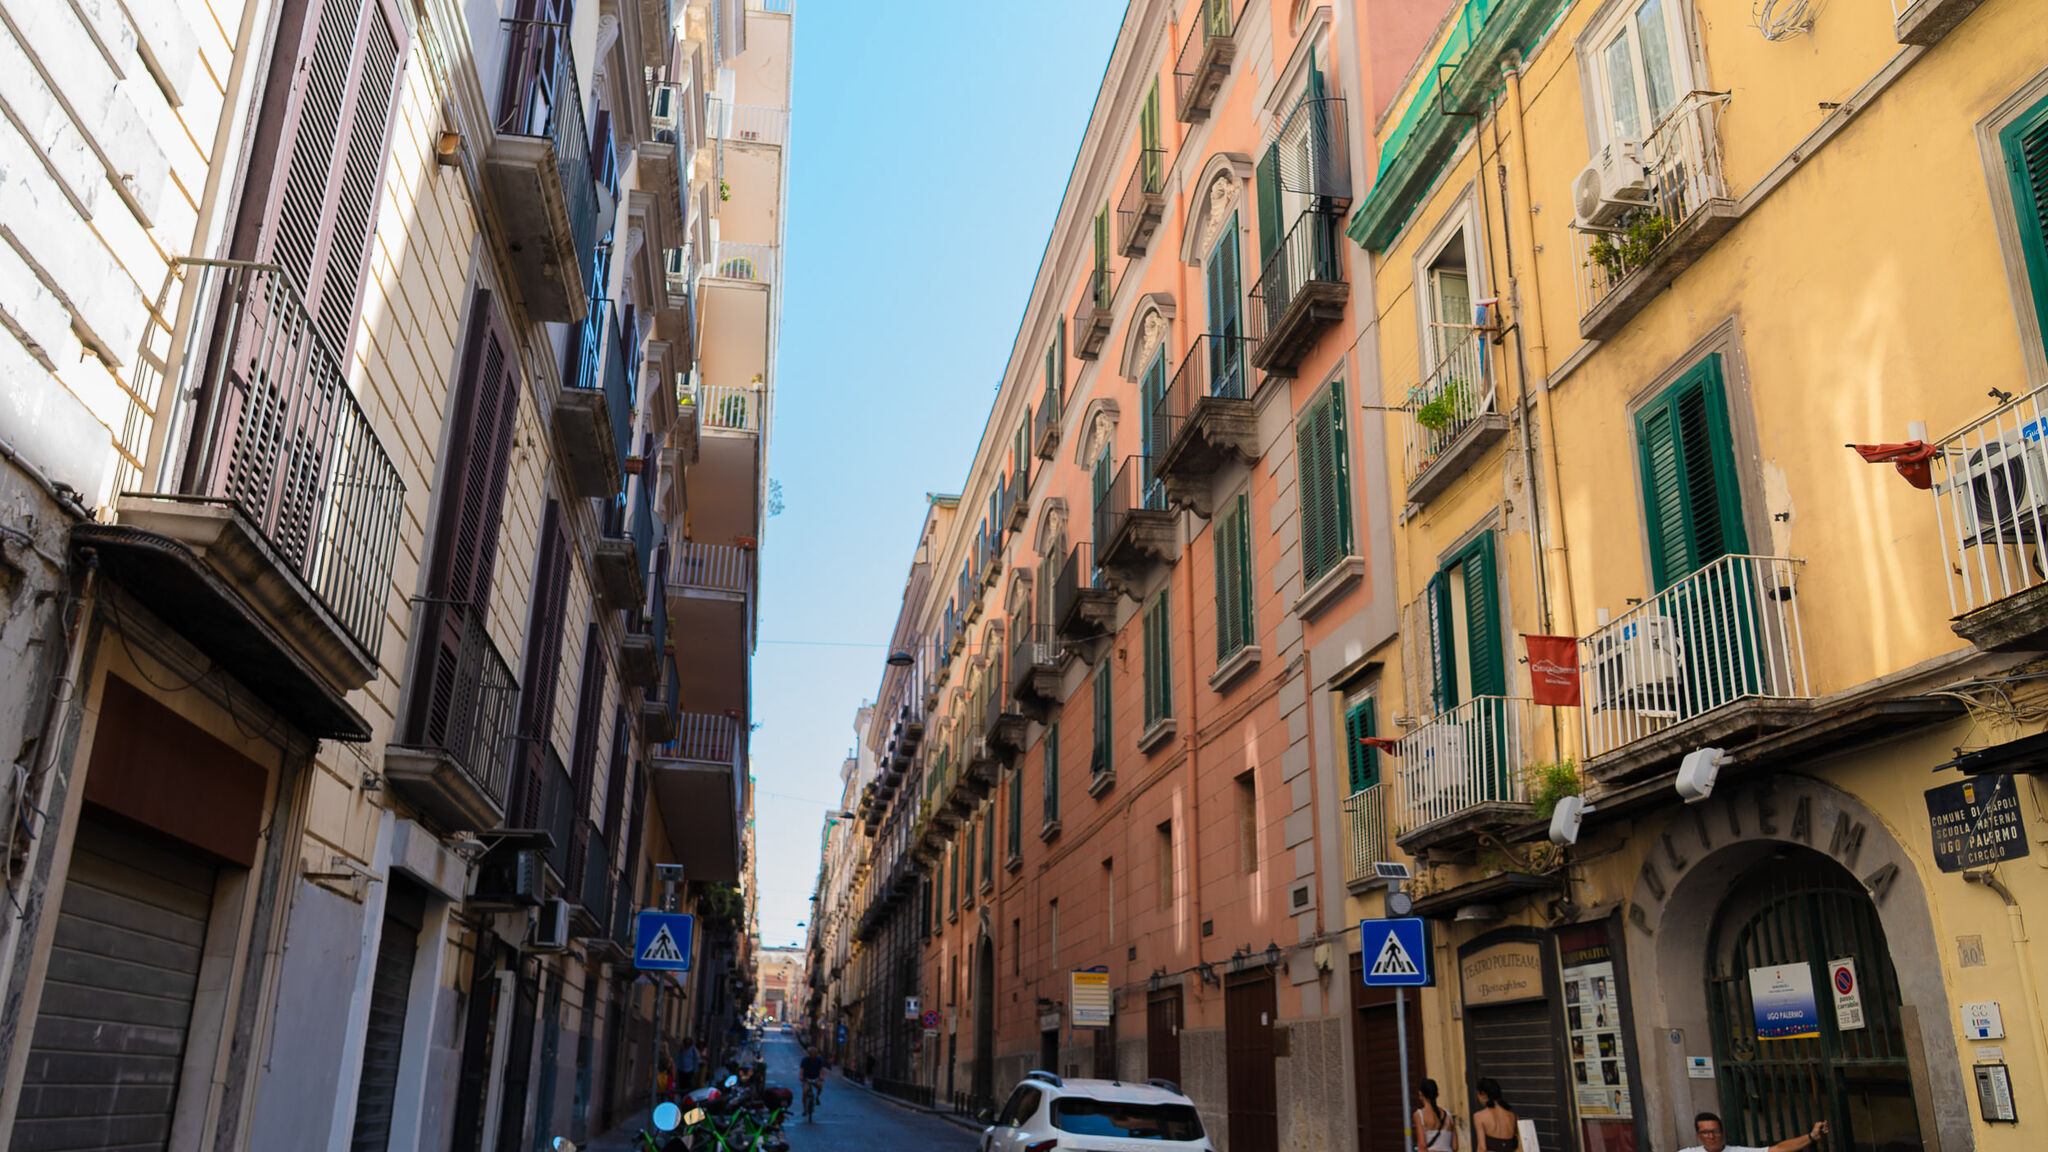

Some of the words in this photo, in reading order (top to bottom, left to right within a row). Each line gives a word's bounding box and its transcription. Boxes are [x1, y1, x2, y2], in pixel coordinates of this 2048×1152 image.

[1931, 809, 1966, 827] COMUNE
[1970, 806, 1981, 818] DI
[1986, 796, 2017, 814] NAPOLI
[1936, 823, 1971, 839] SCUOLA
[1977, 811, 2017, 831] MATERNA
[1940, 839, 1961, 855] UGO
[1969, 826, 2018, 849] PALERMO
[1968, 846, 2006, 863] CIRCOO
[1628, 788, 1900, 936] POLITEAMA
[1464, 956, 1493, 980] TEATRO
[1493, 953, 1540, 972] POLITEAMA
[1767, 1011, 1779, 1020] UGO
[1780, 1010, 1804, 1019] PALERMO
